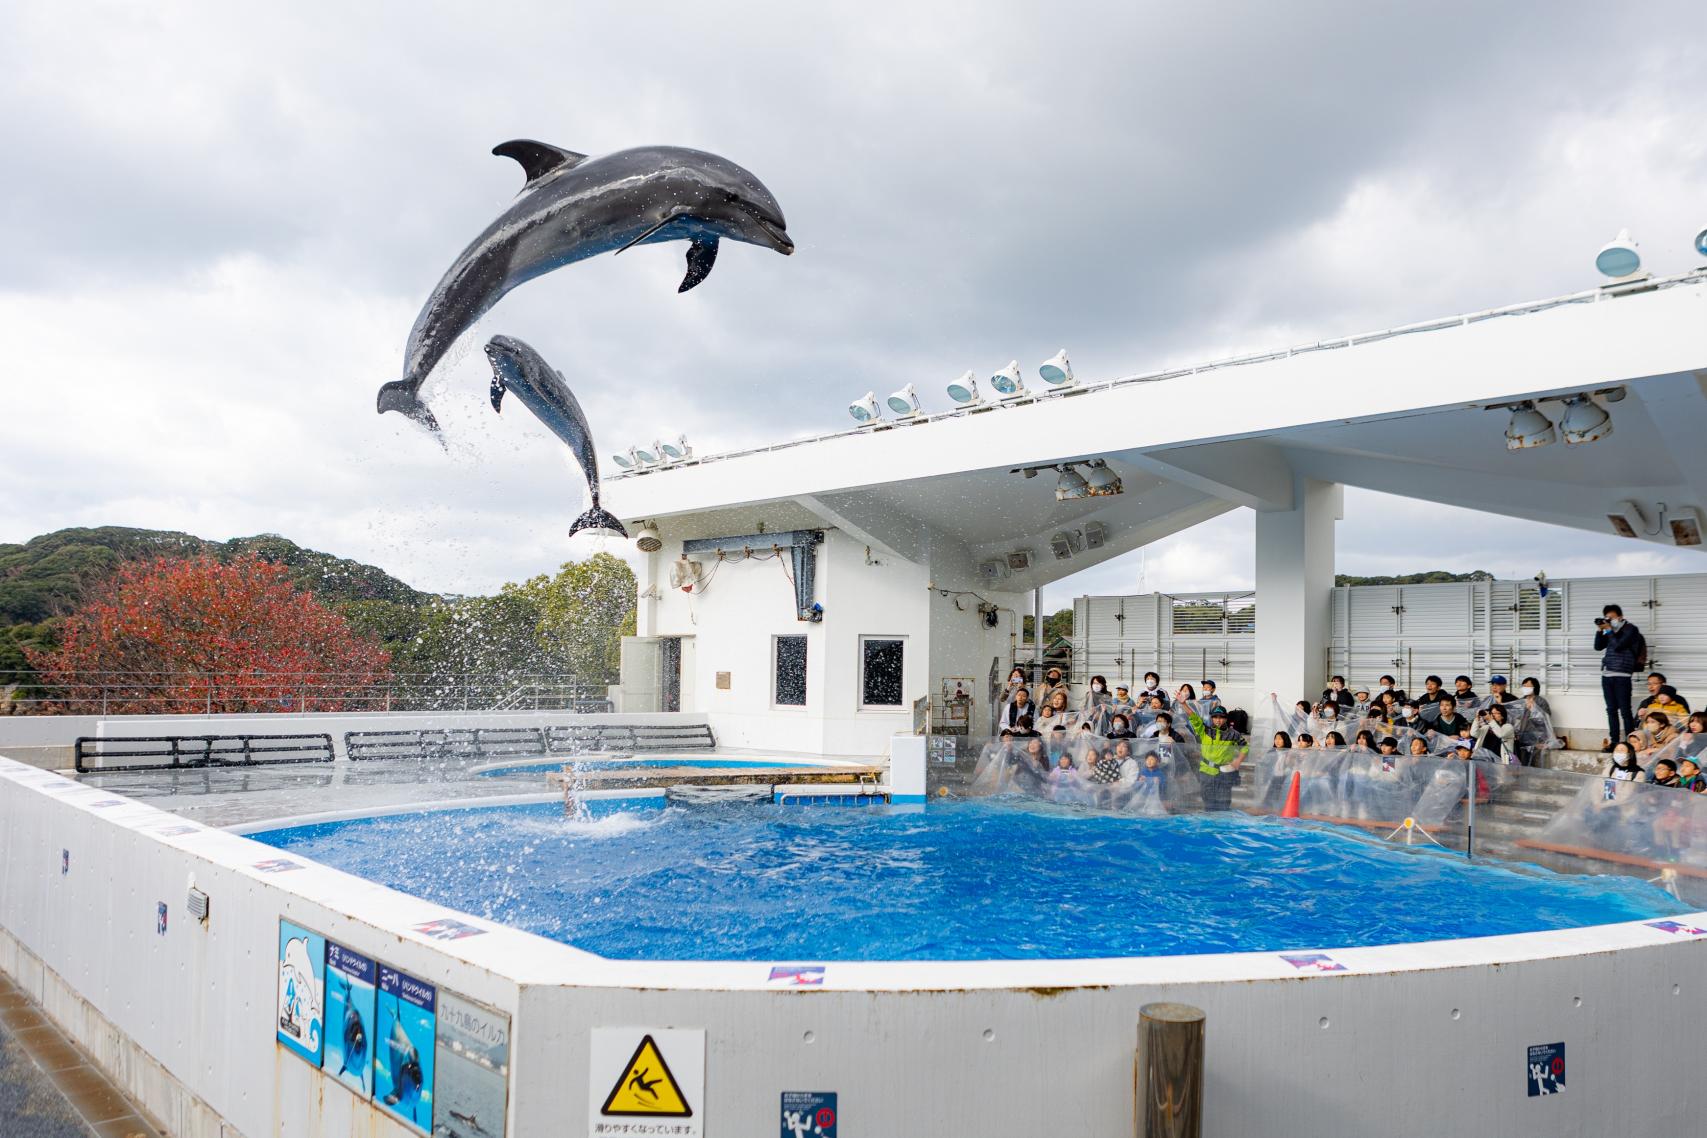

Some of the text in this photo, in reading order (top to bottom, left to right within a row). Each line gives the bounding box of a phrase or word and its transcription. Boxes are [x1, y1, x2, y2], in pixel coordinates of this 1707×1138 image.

[440, 1003, 505, 1047] 九十九島のイルカ
[595, 1123, 697, 1135] 滑りやすくなっています。
